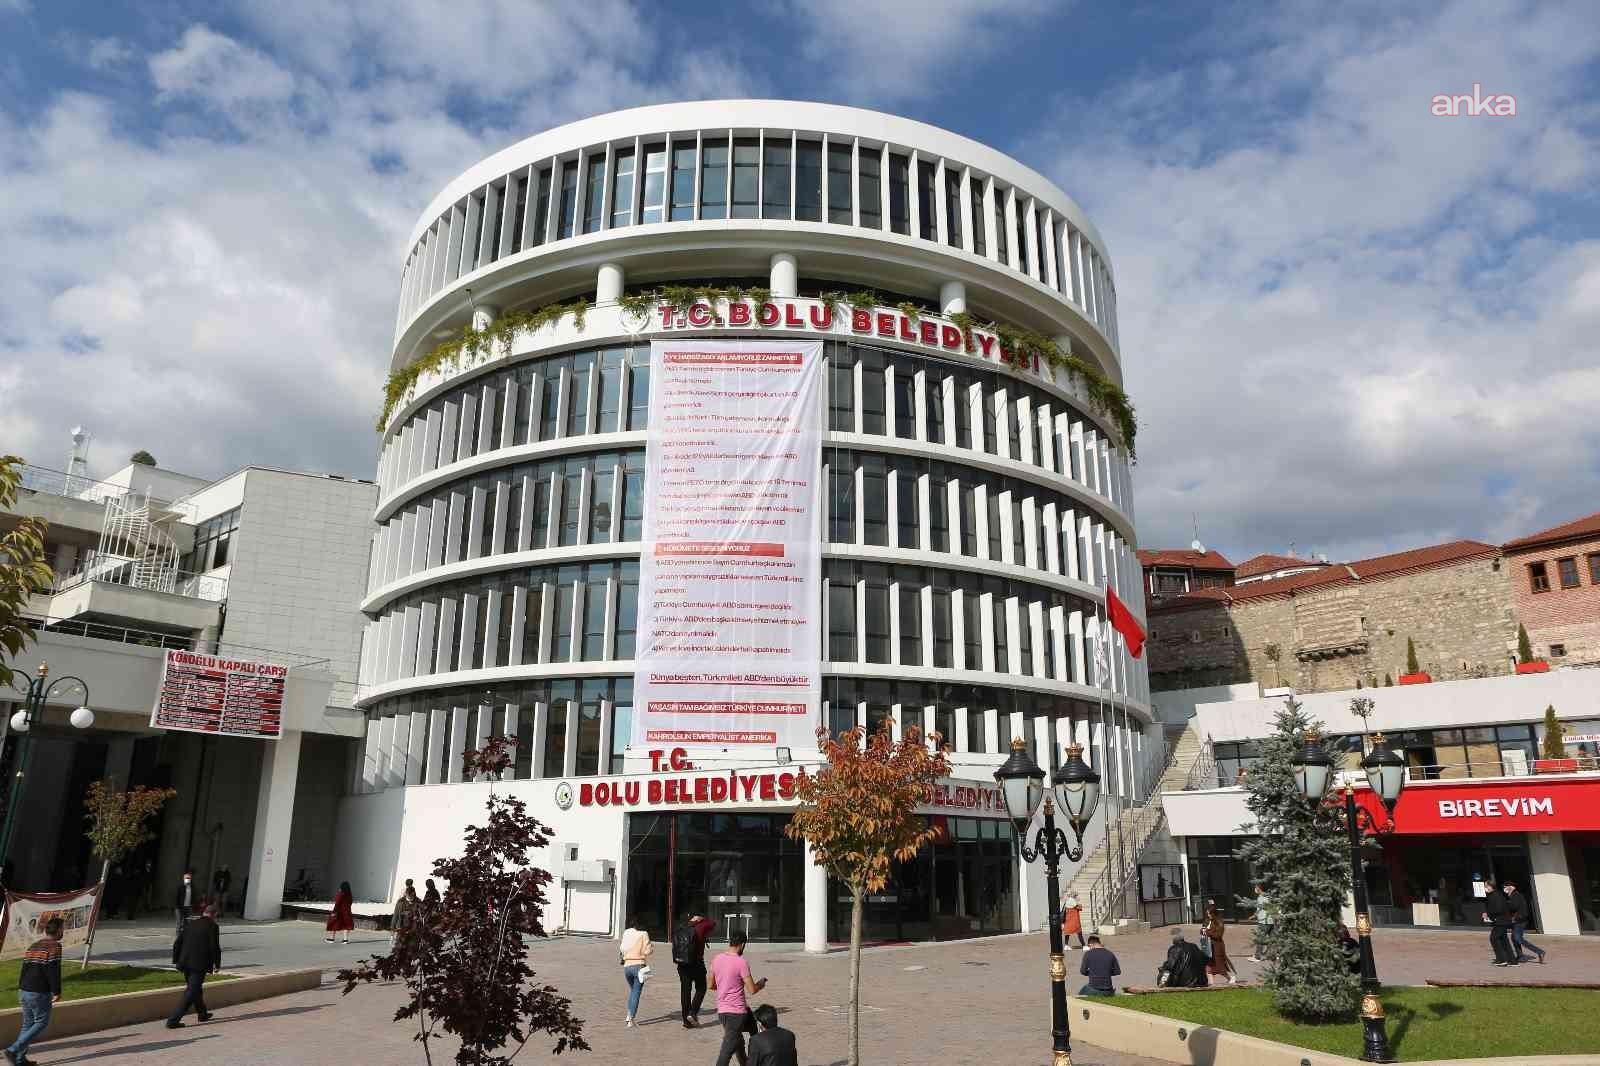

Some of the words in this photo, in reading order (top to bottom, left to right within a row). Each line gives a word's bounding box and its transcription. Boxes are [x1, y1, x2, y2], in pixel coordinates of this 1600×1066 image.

[648, 747, 695, 772] T.C.
[579, 781, 641, 807] BOLU
[1439, 797, 1554, 818] BİREVİM
